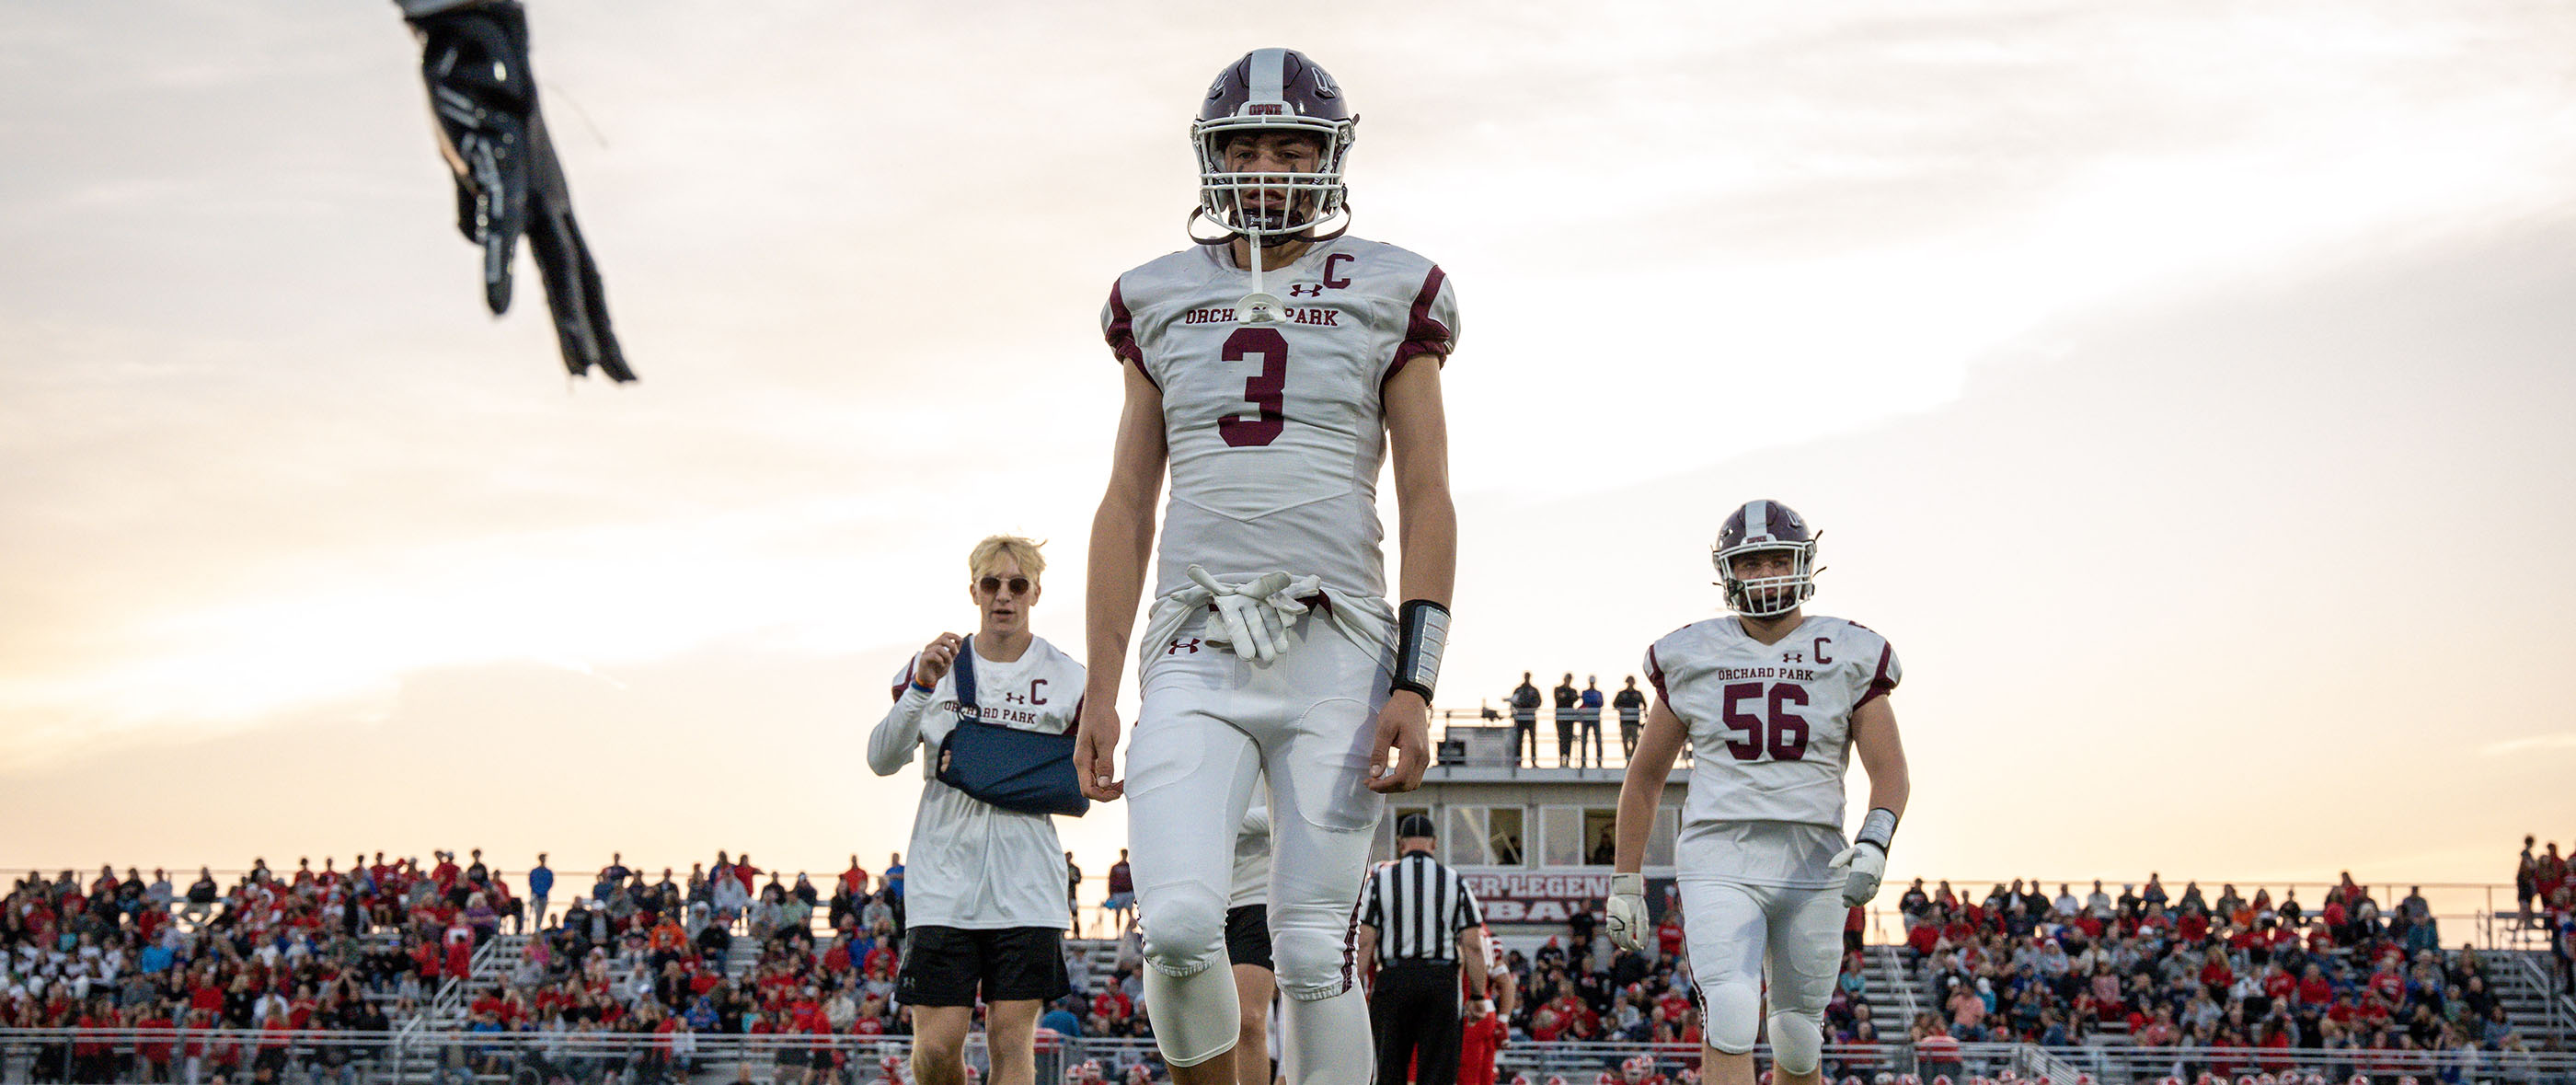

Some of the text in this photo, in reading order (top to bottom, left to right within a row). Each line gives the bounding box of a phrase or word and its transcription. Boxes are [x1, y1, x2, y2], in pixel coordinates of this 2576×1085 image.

[1323, 253, 1355, 290] C
[1185, 306, 1267, 325] ORCH
[1216, 328, 1289, 448] 3
[1813, 637, 1833, 664] C
[1718, 667, 1815, 682] ORCHARD PARK
[1030, 679, 1048, 706] C
[943, 700, 1037, 724] ORHRD PARK
[1722, 682, 1810, 761] 56
[1509, 875, 1611, 898] LEGEN
